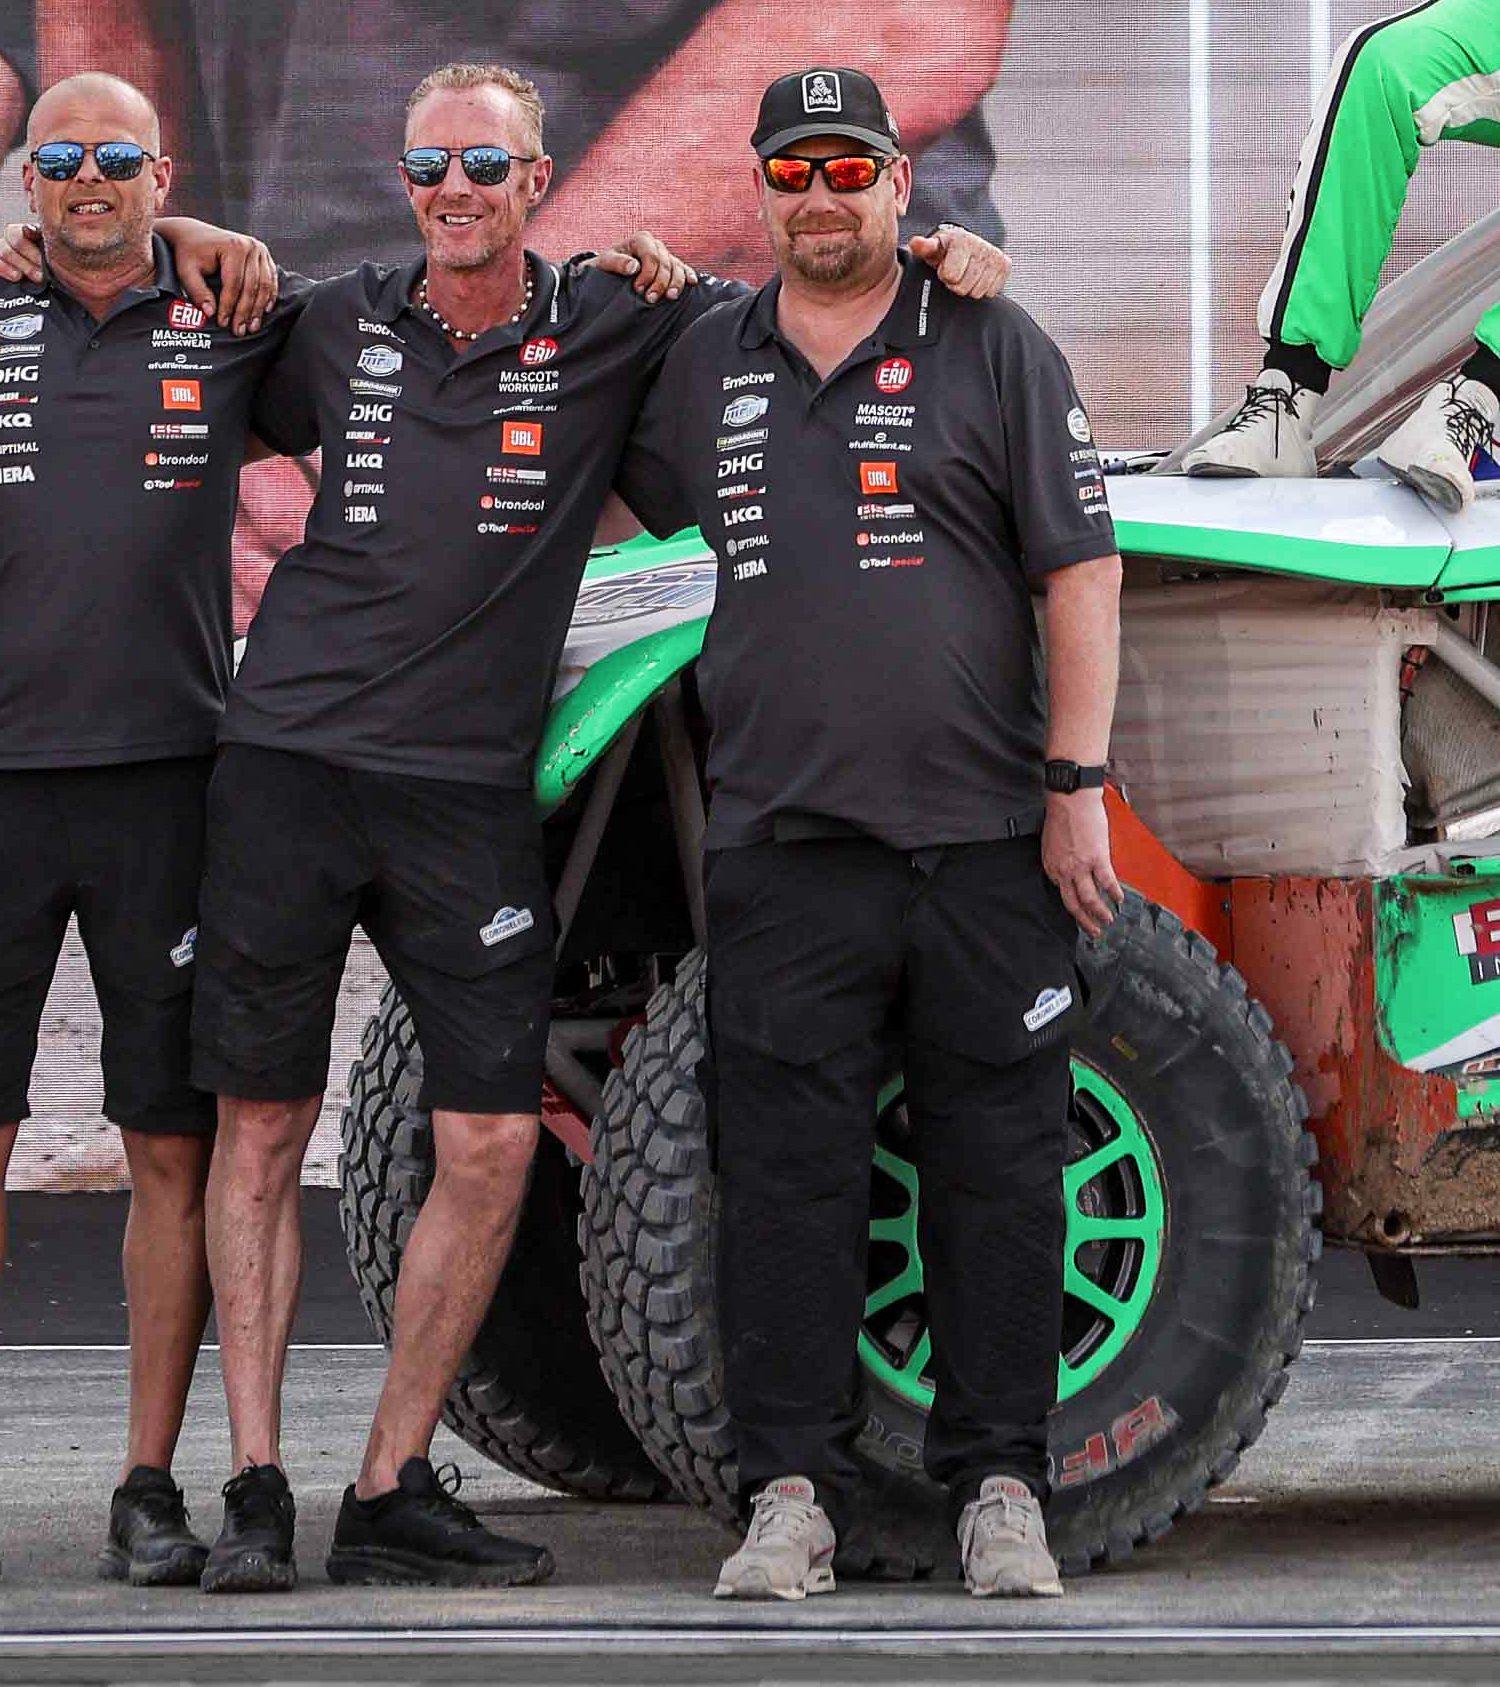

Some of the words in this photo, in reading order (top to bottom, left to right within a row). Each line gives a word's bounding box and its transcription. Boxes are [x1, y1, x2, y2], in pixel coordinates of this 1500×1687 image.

[171, 305, 203, 327] ERU
[151, 337, 212, 350] WORKWEAR
[523, 344, 557, 362] ERU
[722, 372, 776, 391] Emotive
[878, 367, 910, 384] ERU
[498, 382, 559, 393] WORKWEAR
[350, 404, 394, 422] DHG
[854, 415, 913, 428] WORKWEAR
[158, 451, 209, 466] brondool
[346, 453, 384, 470] LKQ
[717, 452, 764, 479] DHG
[493, 497, 545, 512] brondool
[723, 504, 765, 528] LKQ
[737, 534, 770, 552] OPTIMAL
[869, 531, 924, 545] brondool
